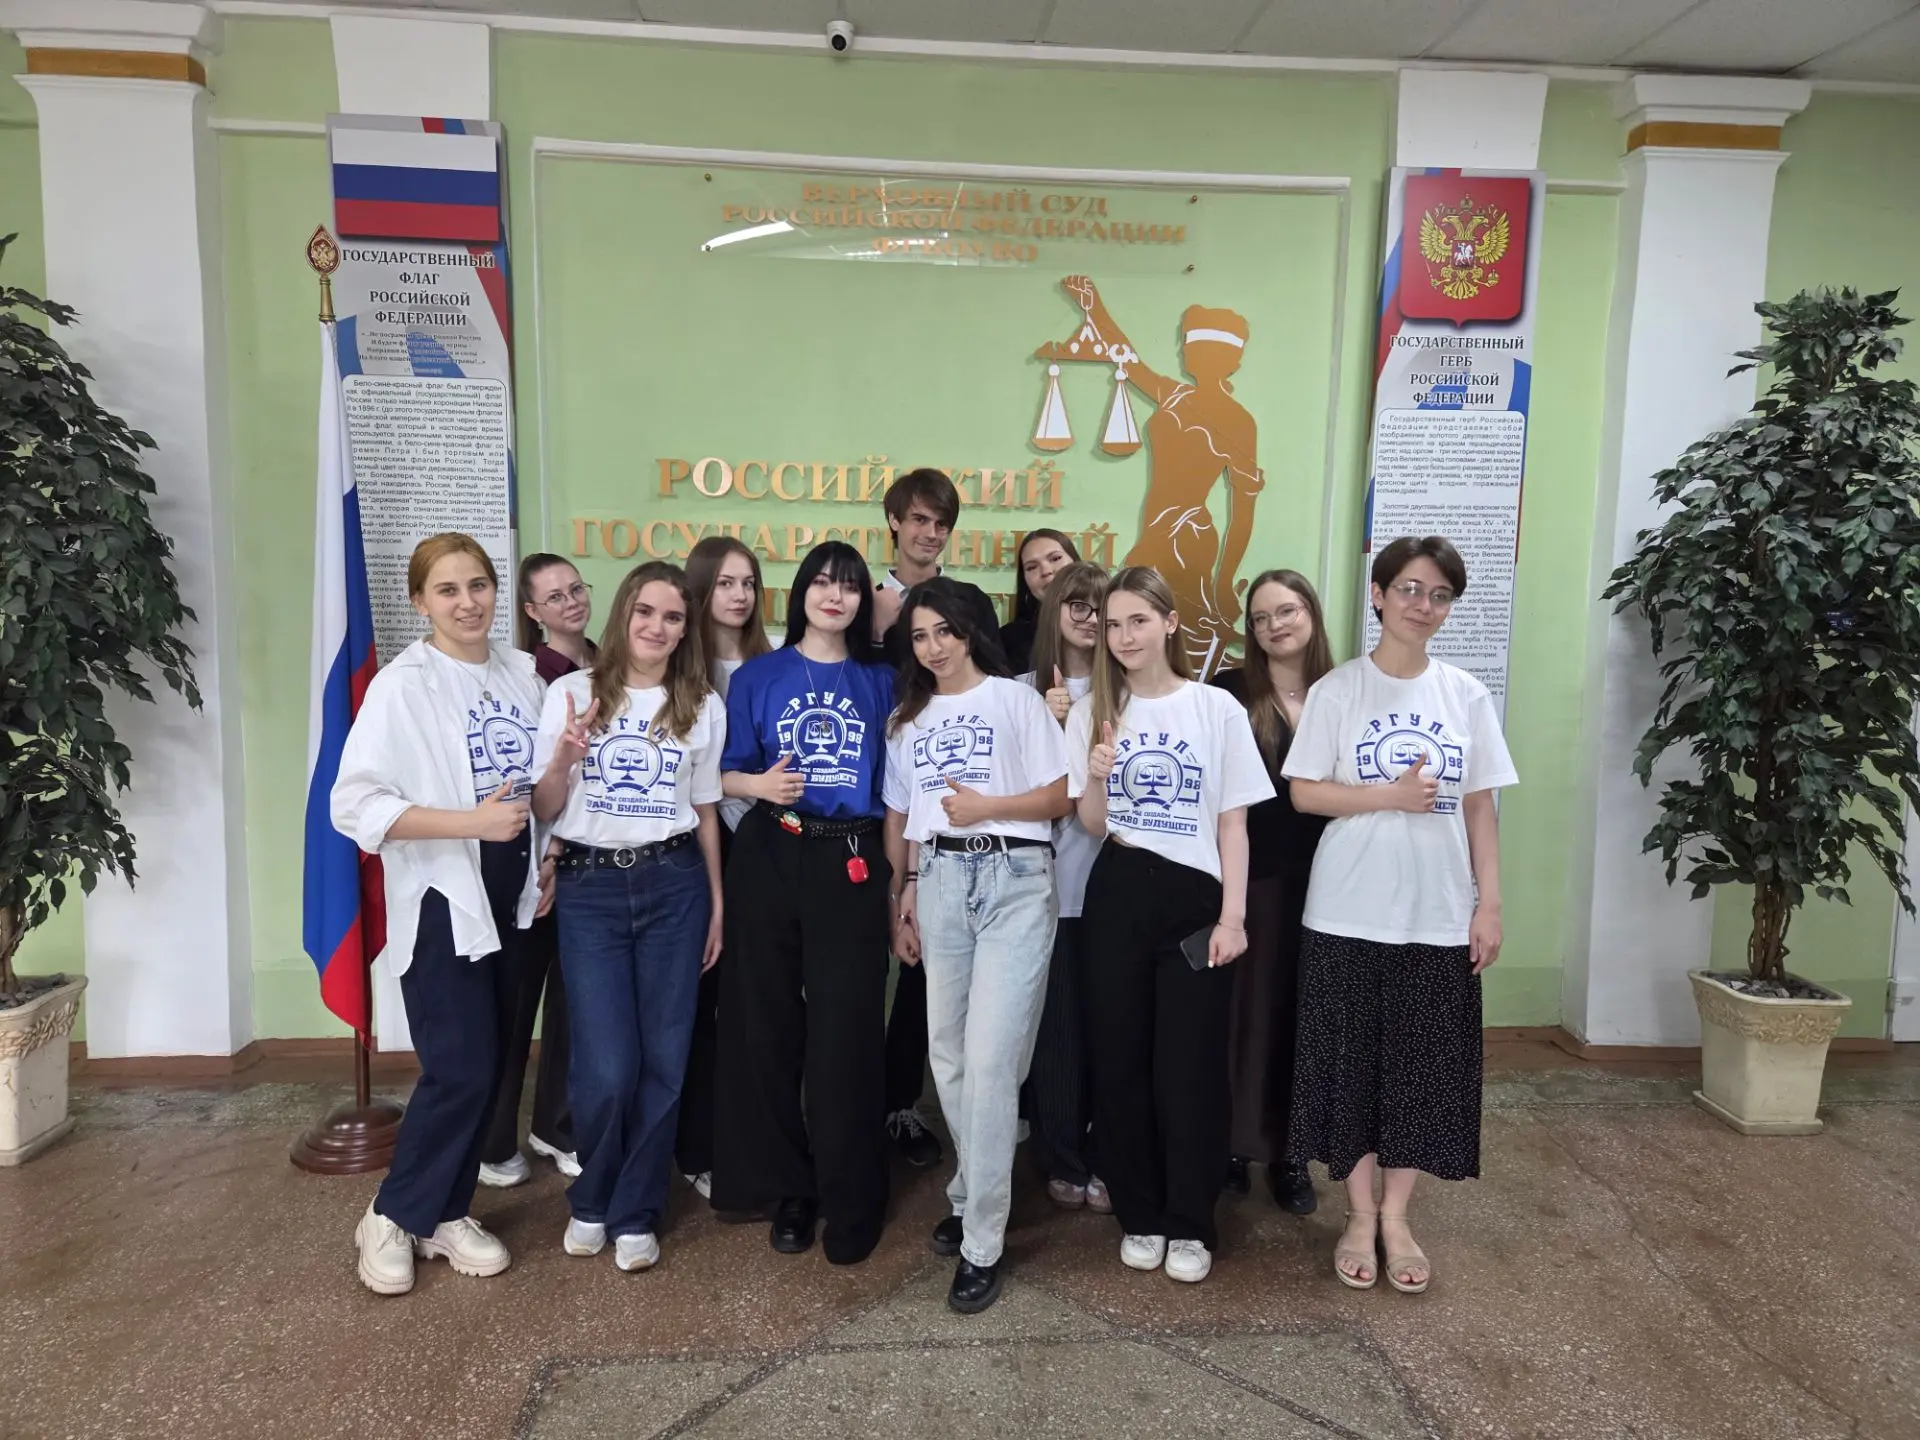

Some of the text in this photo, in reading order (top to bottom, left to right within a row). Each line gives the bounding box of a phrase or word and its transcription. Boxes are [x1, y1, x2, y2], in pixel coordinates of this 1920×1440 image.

[1040, 193, 1107, 218] СУД
[722, 204, 964, 231] РОССИЙСКОЙ
[342, 248, 495, 268] ГОСУДАРСТВЕННЫЙ
[399, 271, 440, 286] ФЛАГ
[369, 289, 471, 306] РОССИЙСКОЙ
[375, 310, 467, 327] ФЕДЕРАЦИИ
[1390, 336, 1524, 350] ГОСУДАРСТВЕННЫЙ
[1440, 355, 1473, 367] ГЕРБ
[446, 382, 462, 390] был
[1410, 372, 1500, 386] РОССИЙСКОЙ
[1413, 392, 1495, 406] ФЕДЕРАЦИИ
[656, 455, 1066, 509] РОССИЙКИЙ
[788, 691, 853, 712] РГУП
[1369, 713, 1443, 735] РГУП
[848, 731, 863, 744] 98
[978, 735, 993, 745] 98
[1120, 732, 1189, 754] РГУП
[664, 761, 679, 774] 98
[1356, 754, 1463, 769] 19 98
[1184, 778, 1201, 790] 98
[617, 804, 676, 816] БУДУЩЕГО
[1142, 818, 1198, 832] БУДУЩЕГО
